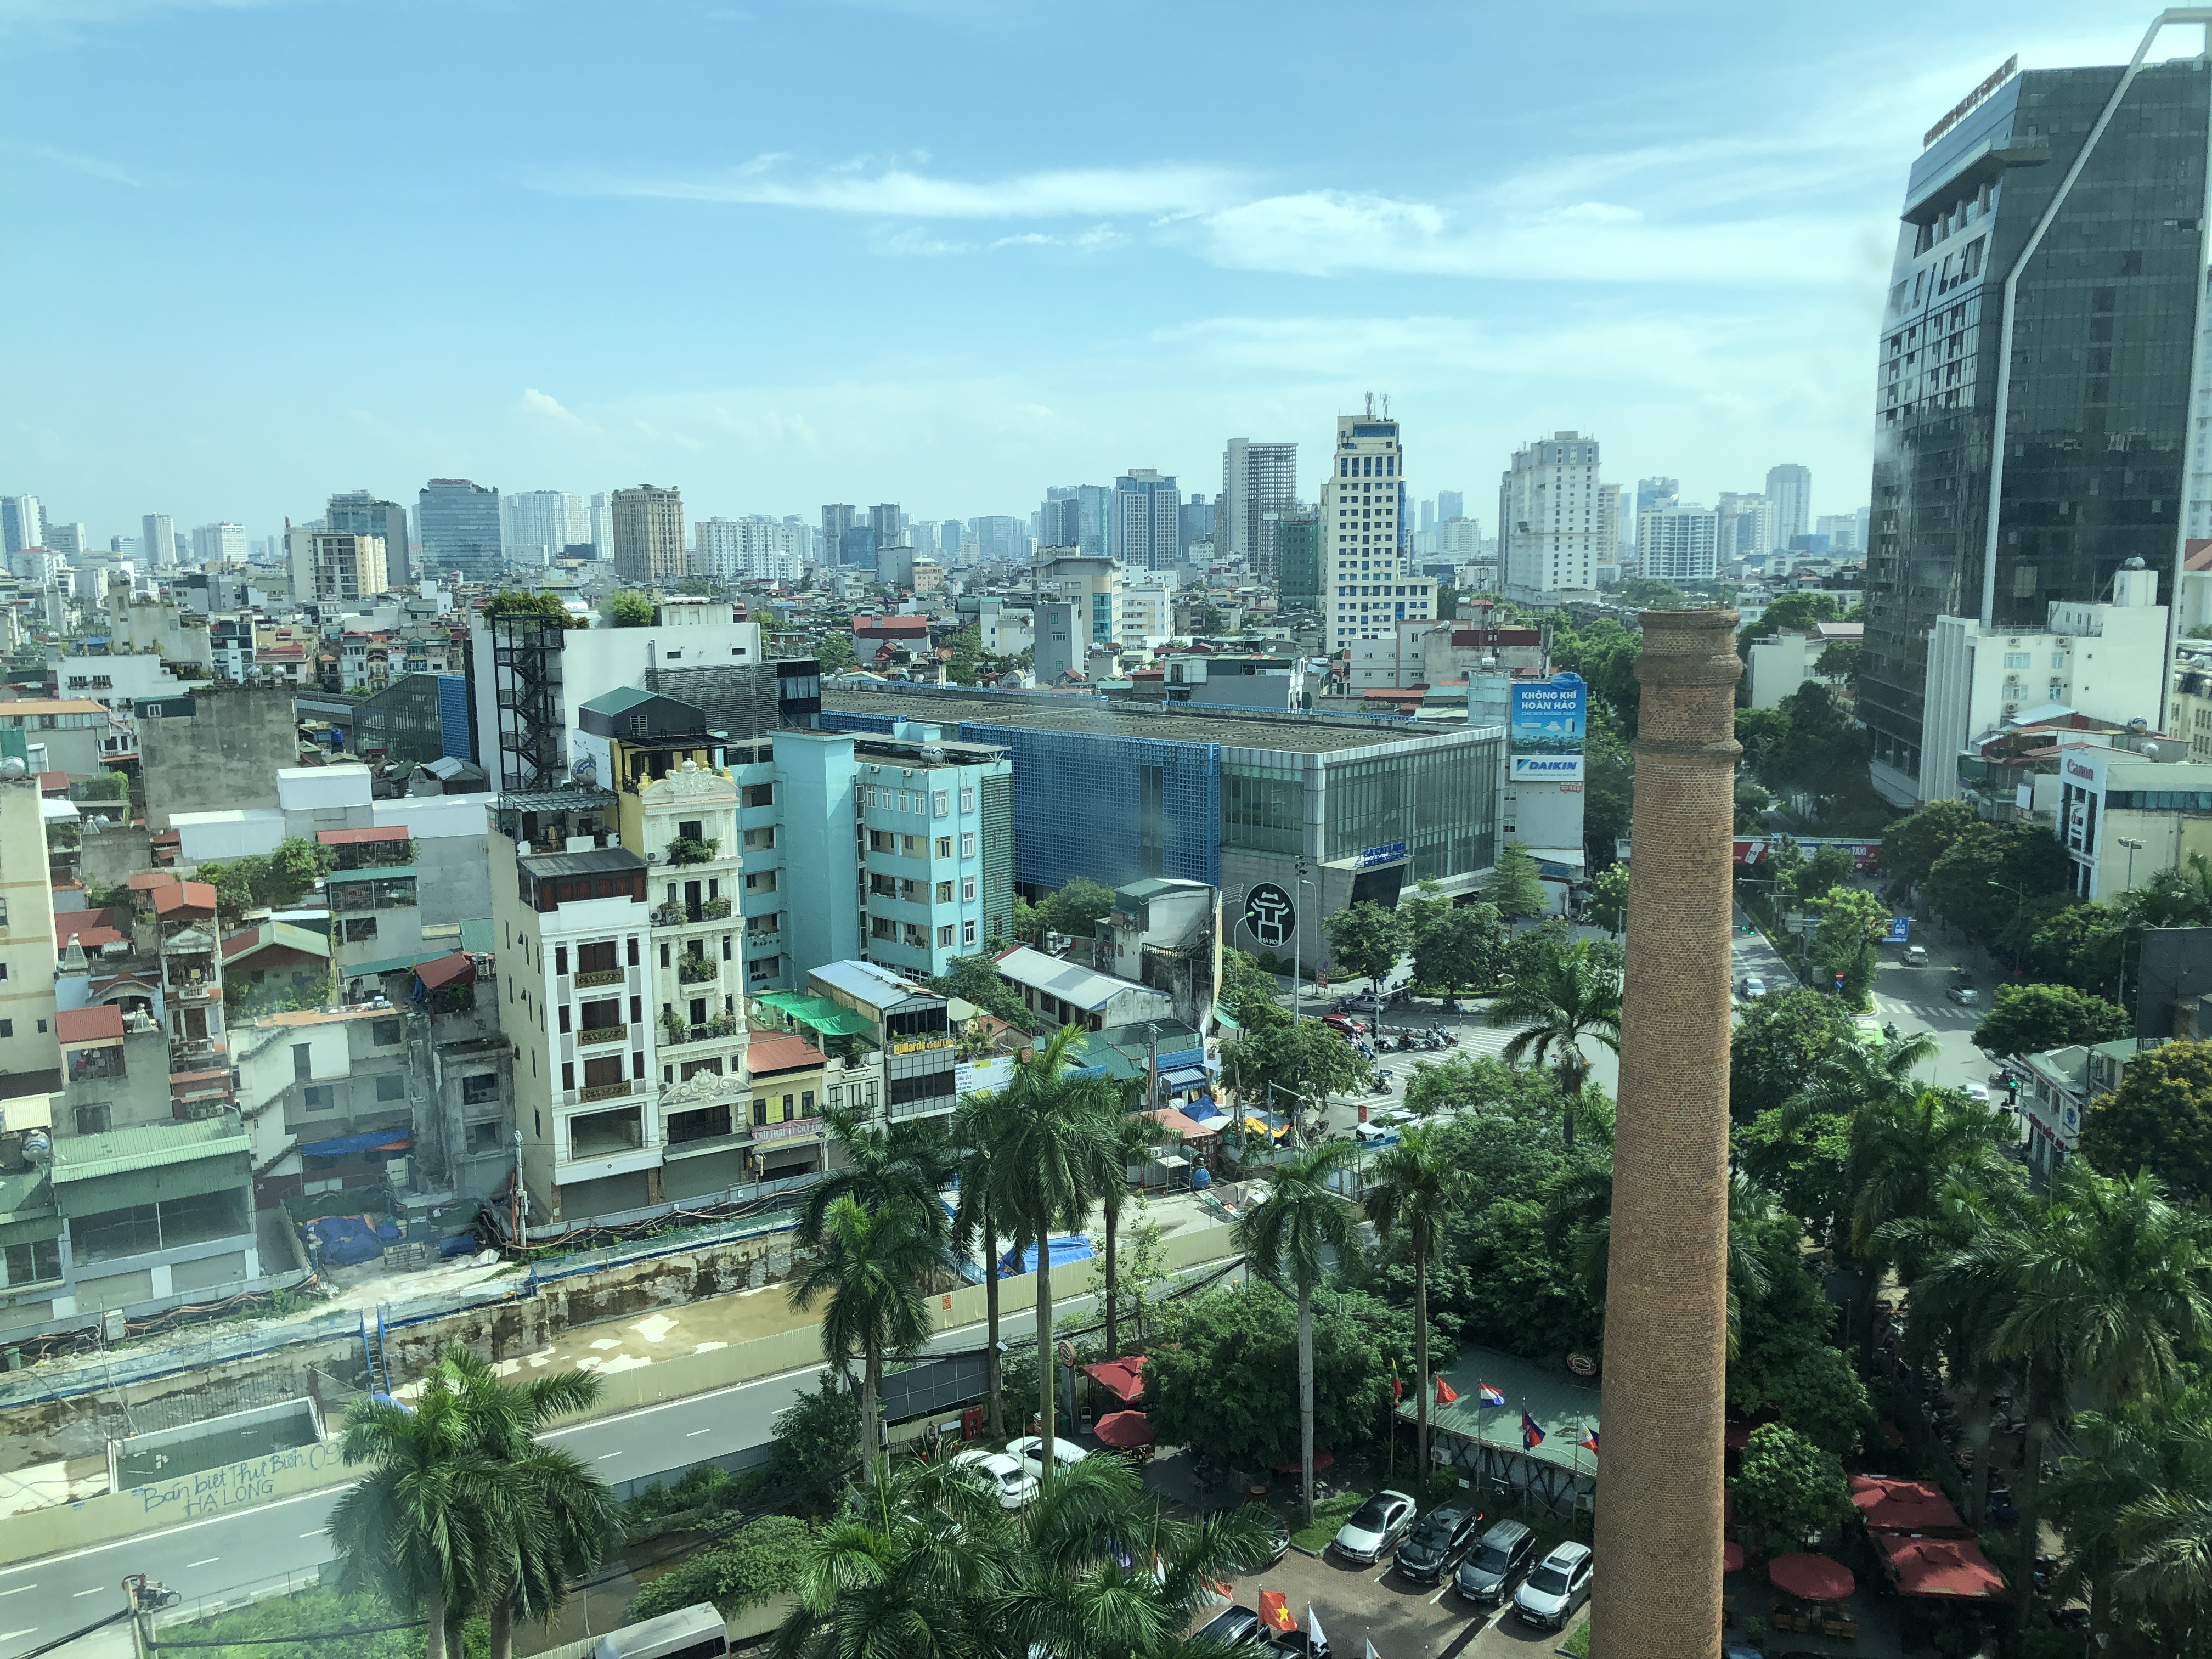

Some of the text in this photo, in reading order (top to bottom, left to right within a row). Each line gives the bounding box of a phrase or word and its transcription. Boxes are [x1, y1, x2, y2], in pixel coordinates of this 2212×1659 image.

[1521, 690, 1577, 699] KHÔNG KHÍ
[1521, 699, 1576, 709] HOÀN HẢO
[1528, 761, 1577, 770] DAIKIN
[2067, 758, 2094, 781] Canon
[894, 1041, 926, 1055] Billiards
[143, 1482, 190, 1513] Bán
[183, 1479, 274, 1517] HẠ LONG
